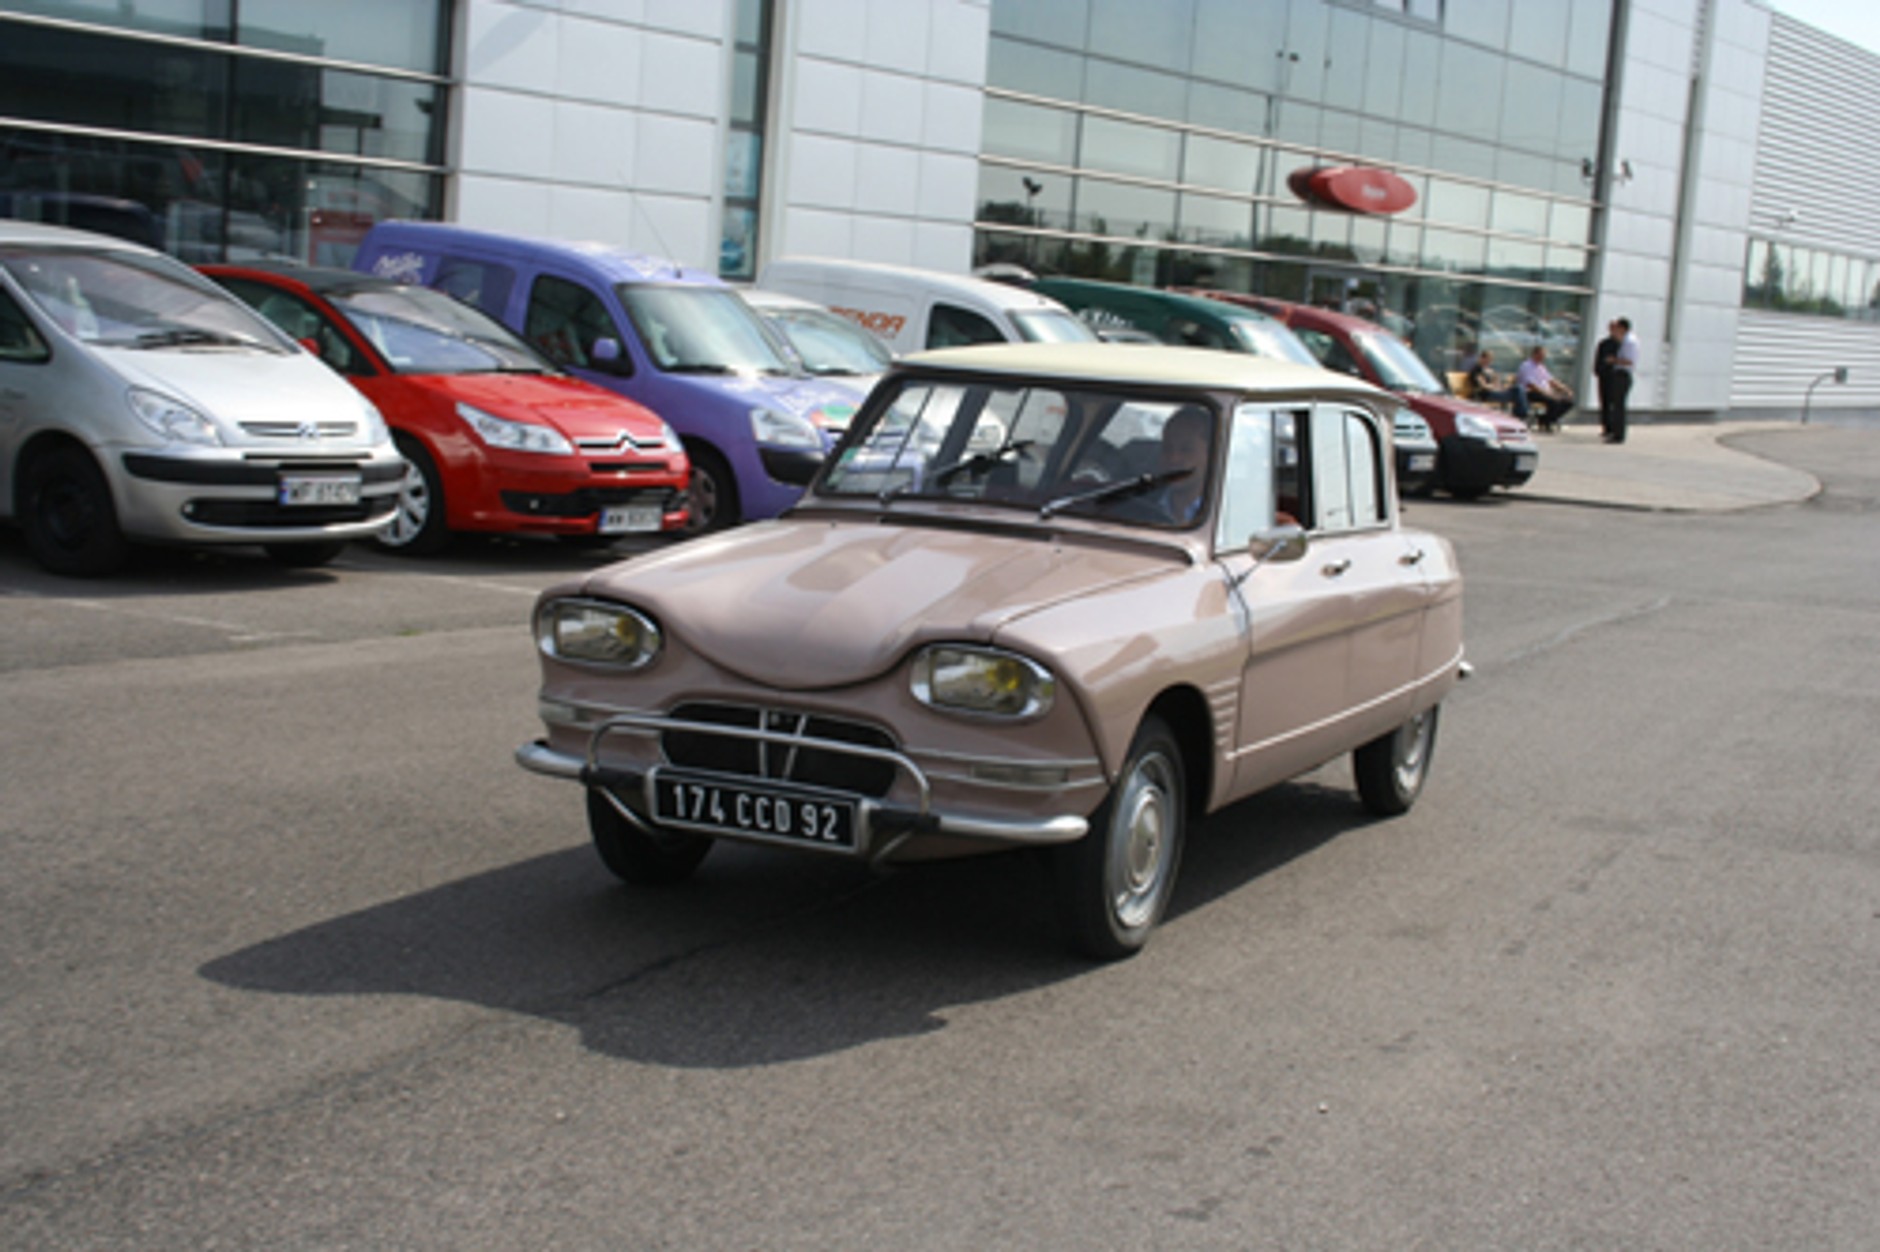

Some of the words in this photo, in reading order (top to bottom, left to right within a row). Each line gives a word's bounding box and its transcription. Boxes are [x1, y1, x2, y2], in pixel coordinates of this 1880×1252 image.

[673, 784, 725, 824] 174
[736, 793, 791, 833] CCD
[801, 803, 838, 840] 92
